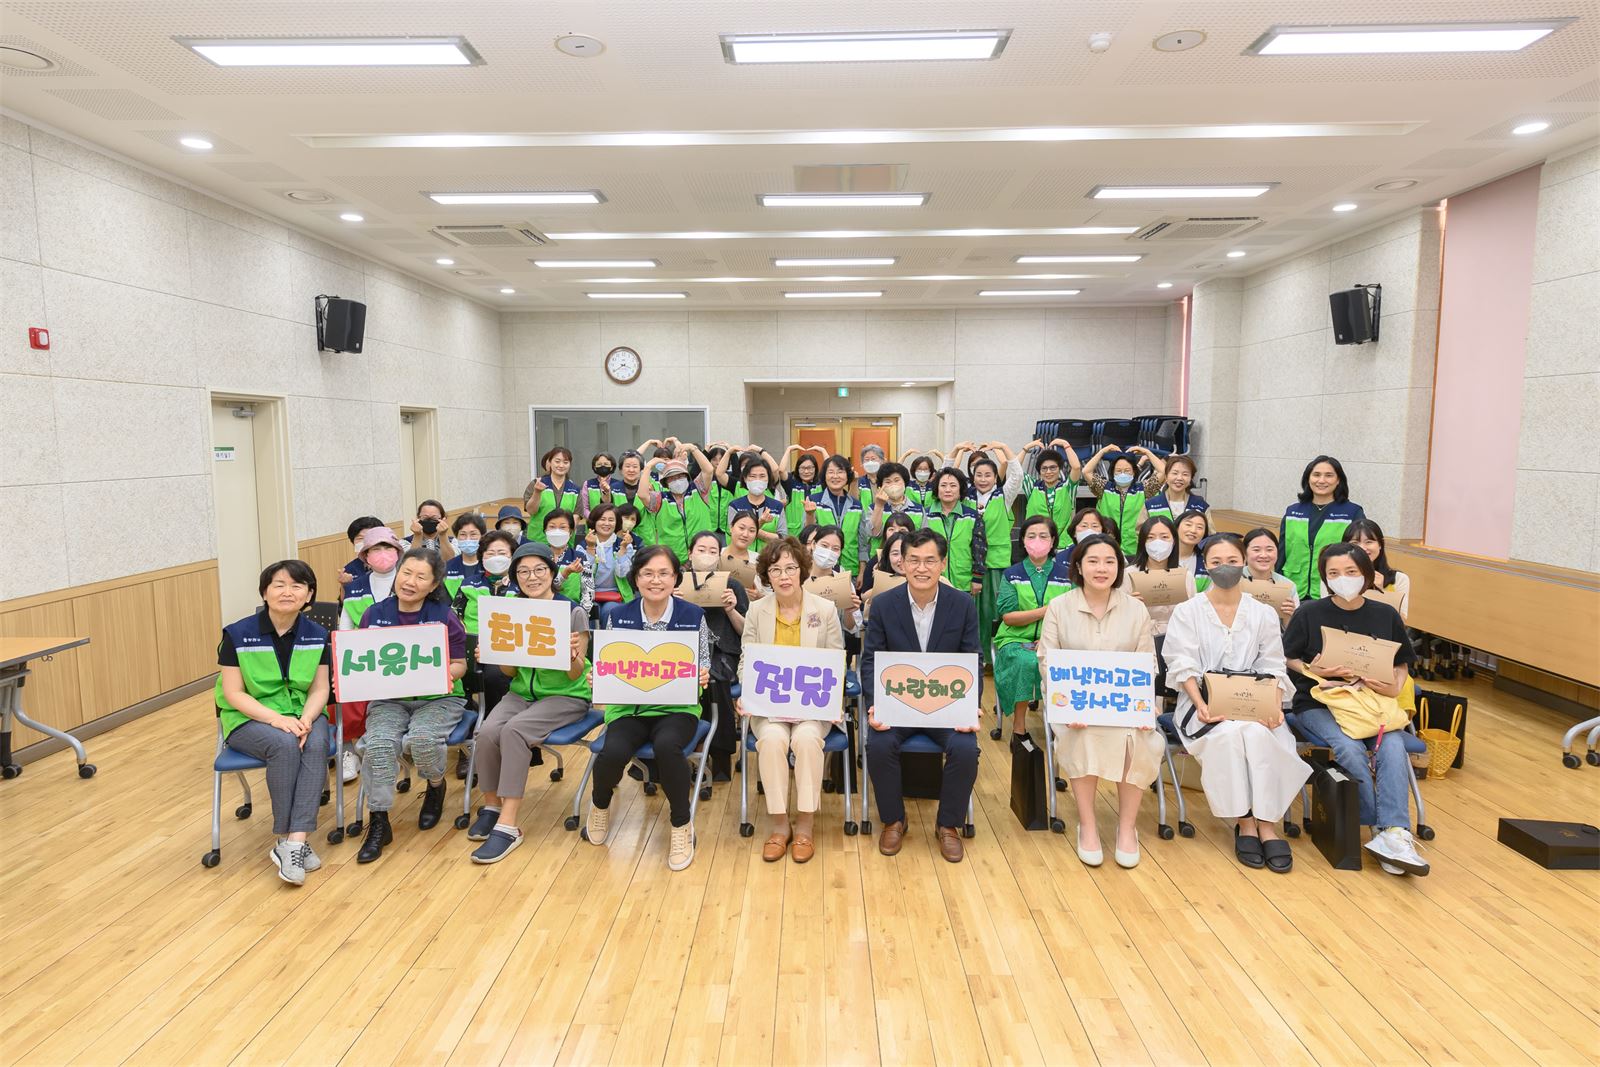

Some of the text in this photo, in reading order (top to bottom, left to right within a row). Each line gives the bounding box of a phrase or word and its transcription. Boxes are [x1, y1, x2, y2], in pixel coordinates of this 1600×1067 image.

[488, 612, 556, 656] 최초
[342, 643, 441, 676] 서울시
[596, 660, 697, 680] 배냇저고리
[753, 660, 838, 708] 전달
[1049, 666, 1151, 687] 배냇저고리
[885, 678, 966, 699] 사랑해요
[1070, 690, 1131, 712] 봉사단
